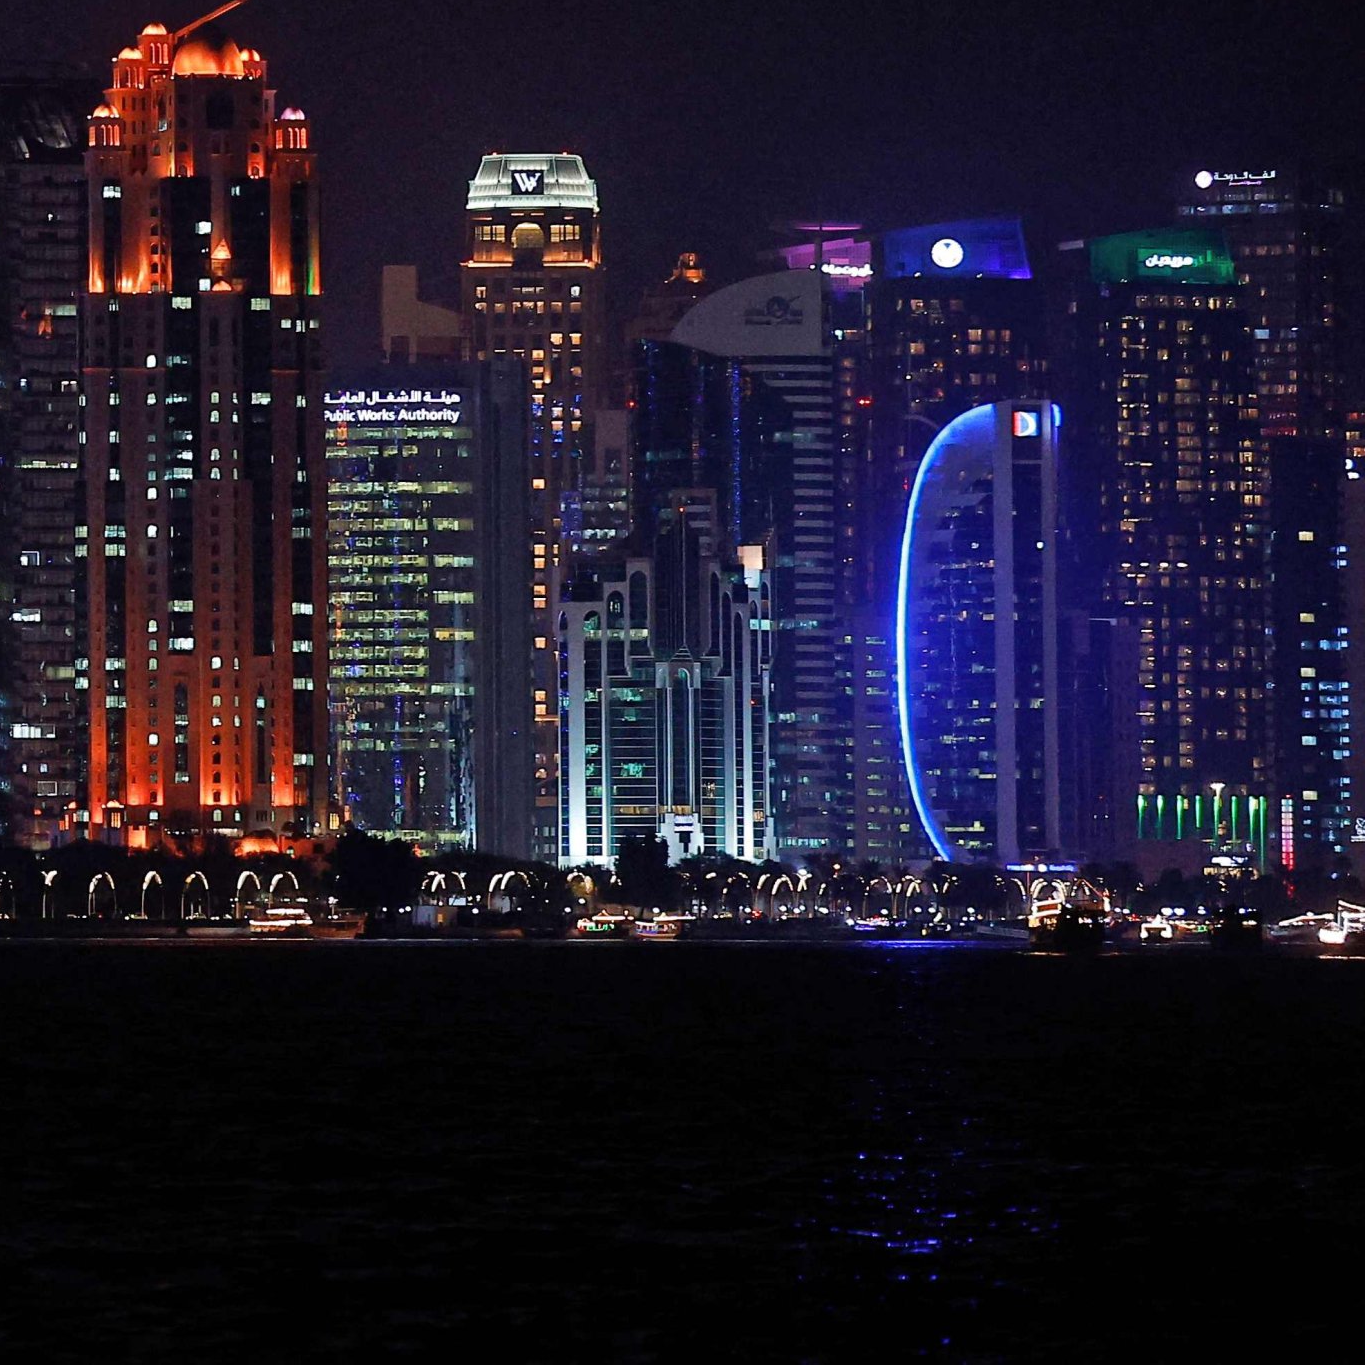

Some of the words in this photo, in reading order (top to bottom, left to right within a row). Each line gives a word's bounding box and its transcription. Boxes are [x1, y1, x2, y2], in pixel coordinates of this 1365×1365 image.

[323, 391, 365, 404] العامة
[324, 408, 356, 422] Public
[357, 408, 396, 422] Works
[397, 408, 461, 424] Authority
